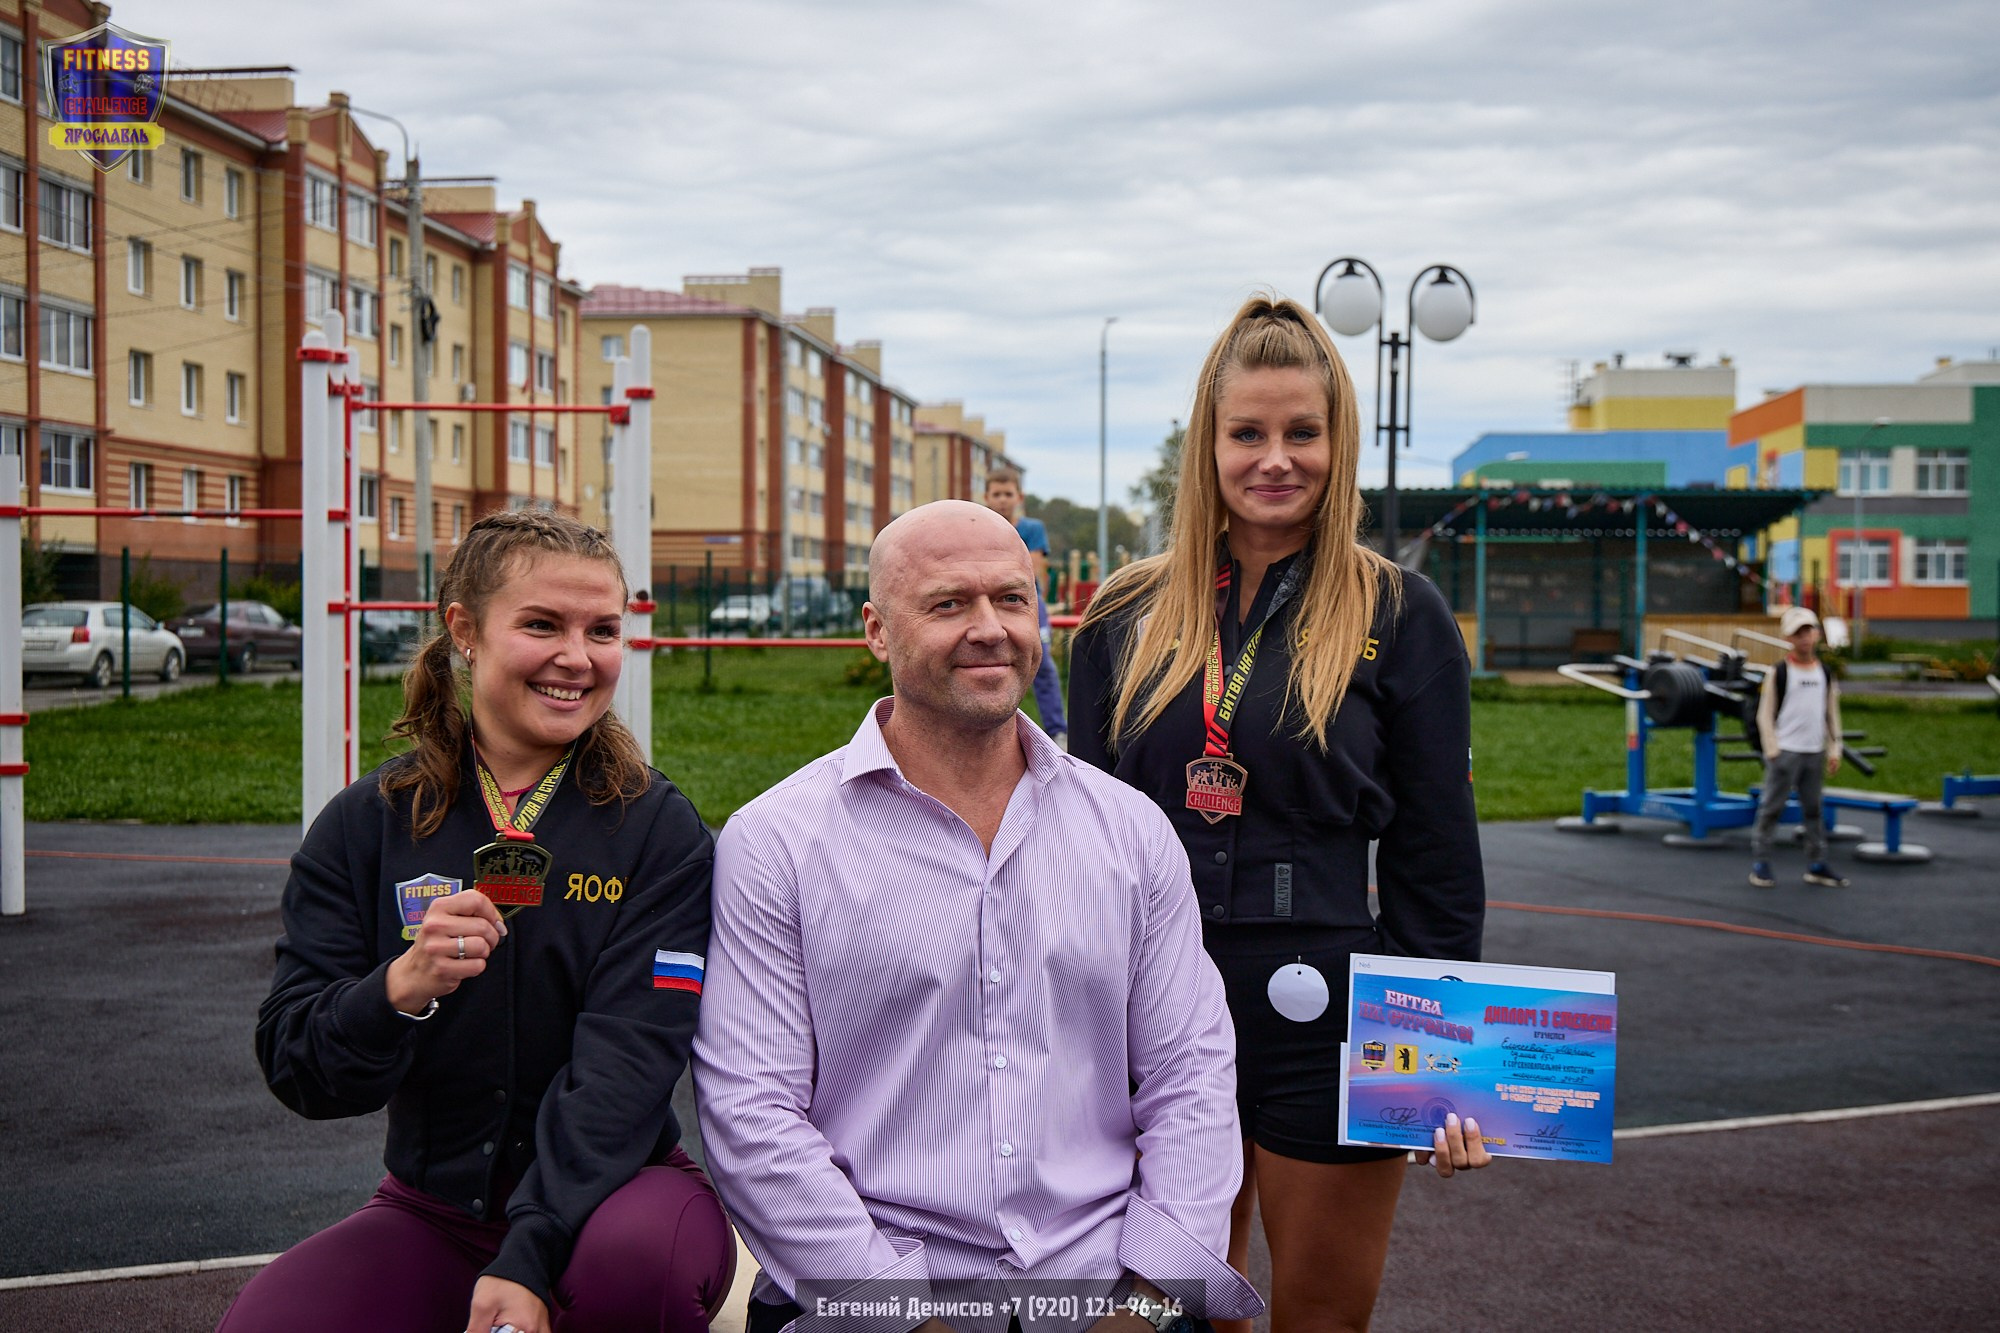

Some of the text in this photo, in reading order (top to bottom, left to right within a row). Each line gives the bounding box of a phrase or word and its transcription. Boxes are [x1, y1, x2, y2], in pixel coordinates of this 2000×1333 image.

[1219, 625, 1265, 722] БИТВА НА СТР
[1211, 694, 1220, 707] ПО
[1194, 784, 1237, 796] FITNESS
[513, 800, 542, 833] БИТВА
[531, 791, 549, 805] НА
[1188, 792, 1241, 812] CHALLENGE
[483, 874, 538, 884] FITNESS
[564, 873, 629, 903] ЯОФ
[405, 883, 452, 899] FITNESS
[479, 885, 541, 903] CHALLENGE
[1385, 989, 1444, 1017] БИТВА
[1484, 1005, 1537, 1026] ДИПЛОМ
[1552, 1011, 1613, 1032] СТЕПЕНИ
